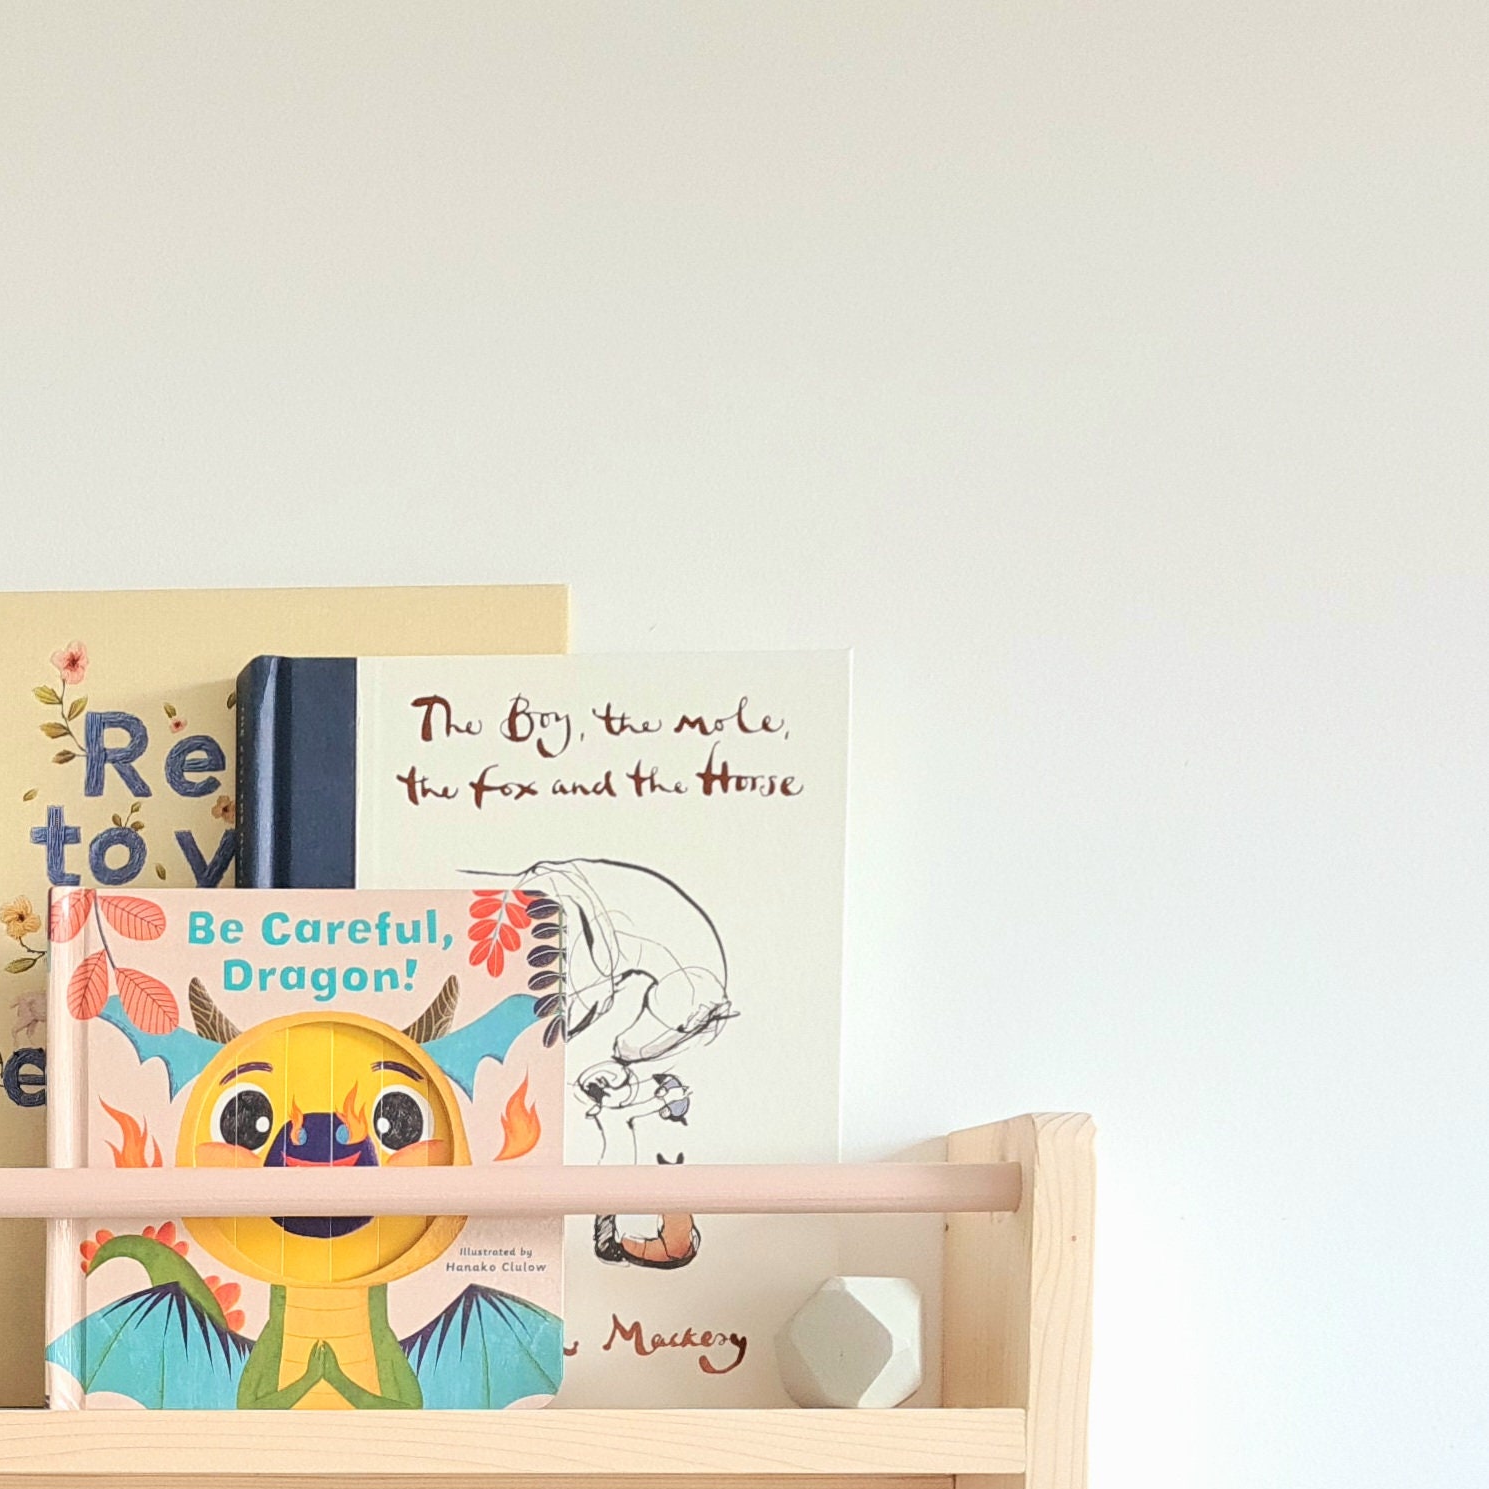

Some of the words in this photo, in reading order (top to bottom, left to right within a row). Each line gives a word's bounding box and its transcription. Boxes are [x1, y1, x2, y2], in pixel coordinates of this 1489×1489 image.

[409, 693, 482, 742] The
[499, 692, 585, 758] Boy,
[591, 701, 663, 737] the
[395, 765, 460, 806] the
[467, 764, 540, 810] fox
[551, 769, 619, 799] and
[625, 758, 689, 798] the
[695, 740, 805, 798] Horse
[30, 805, 148, 887] to
[187, 910, 245, 946] Be
[260, 908, 455, 951] Careful,
[222, 958, 419, 1003] Dragon!
[445, 1261, 497, 1273] Hanako
[501, 1261, 548, 1273] Clulow
[458, 1246, 517, 1257] Illustrated
[519, 1246, 533, 1259] by
[602, 1313, 748, 1375] Mackesy
